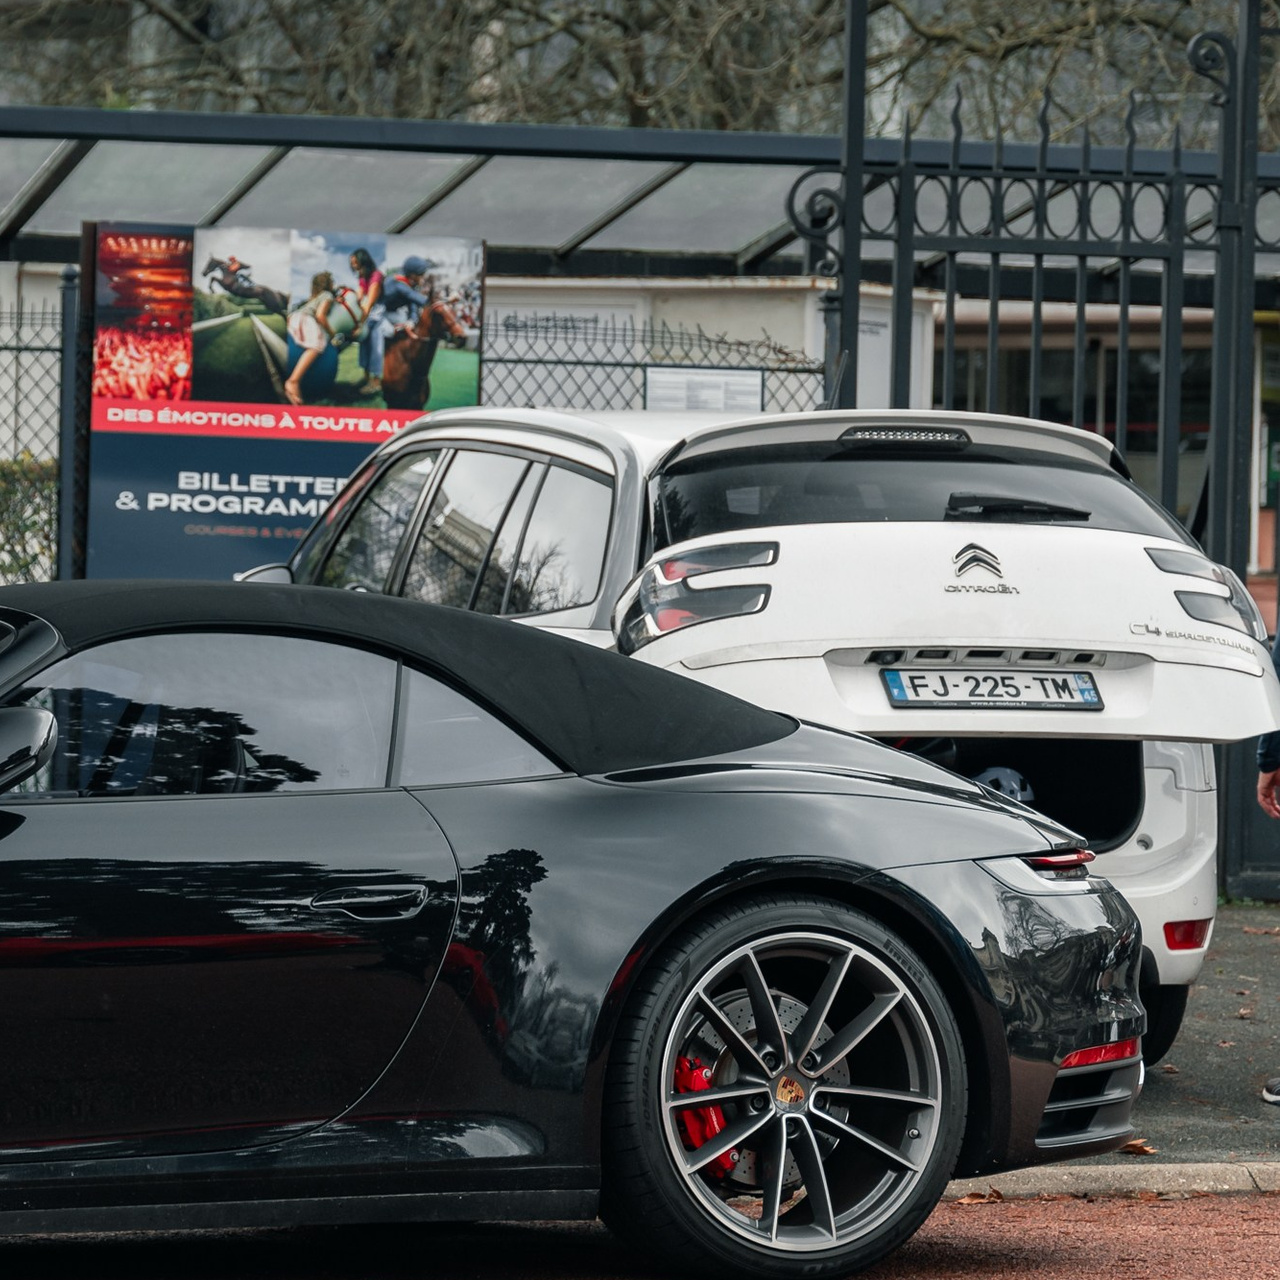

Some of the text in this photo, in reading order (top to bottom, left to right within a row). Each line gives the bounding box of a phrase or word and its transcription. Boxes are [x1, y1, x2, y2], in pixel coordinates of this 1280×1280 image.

[107, 408, 154, 423] DES
[157, 407, 276, 428] ÉMOTIONS
[279, 412, 296, 430] À
[299, 416, 373, 433] TOUTE
[115, 491, 140, 511] &
[1129, 622, 1162, 637] C4
[908, 674, 1075, 700] FJ-225-TM
[1083, 691, 1098, 702] 45
[883, 938, 925, 984] PIRELLI
